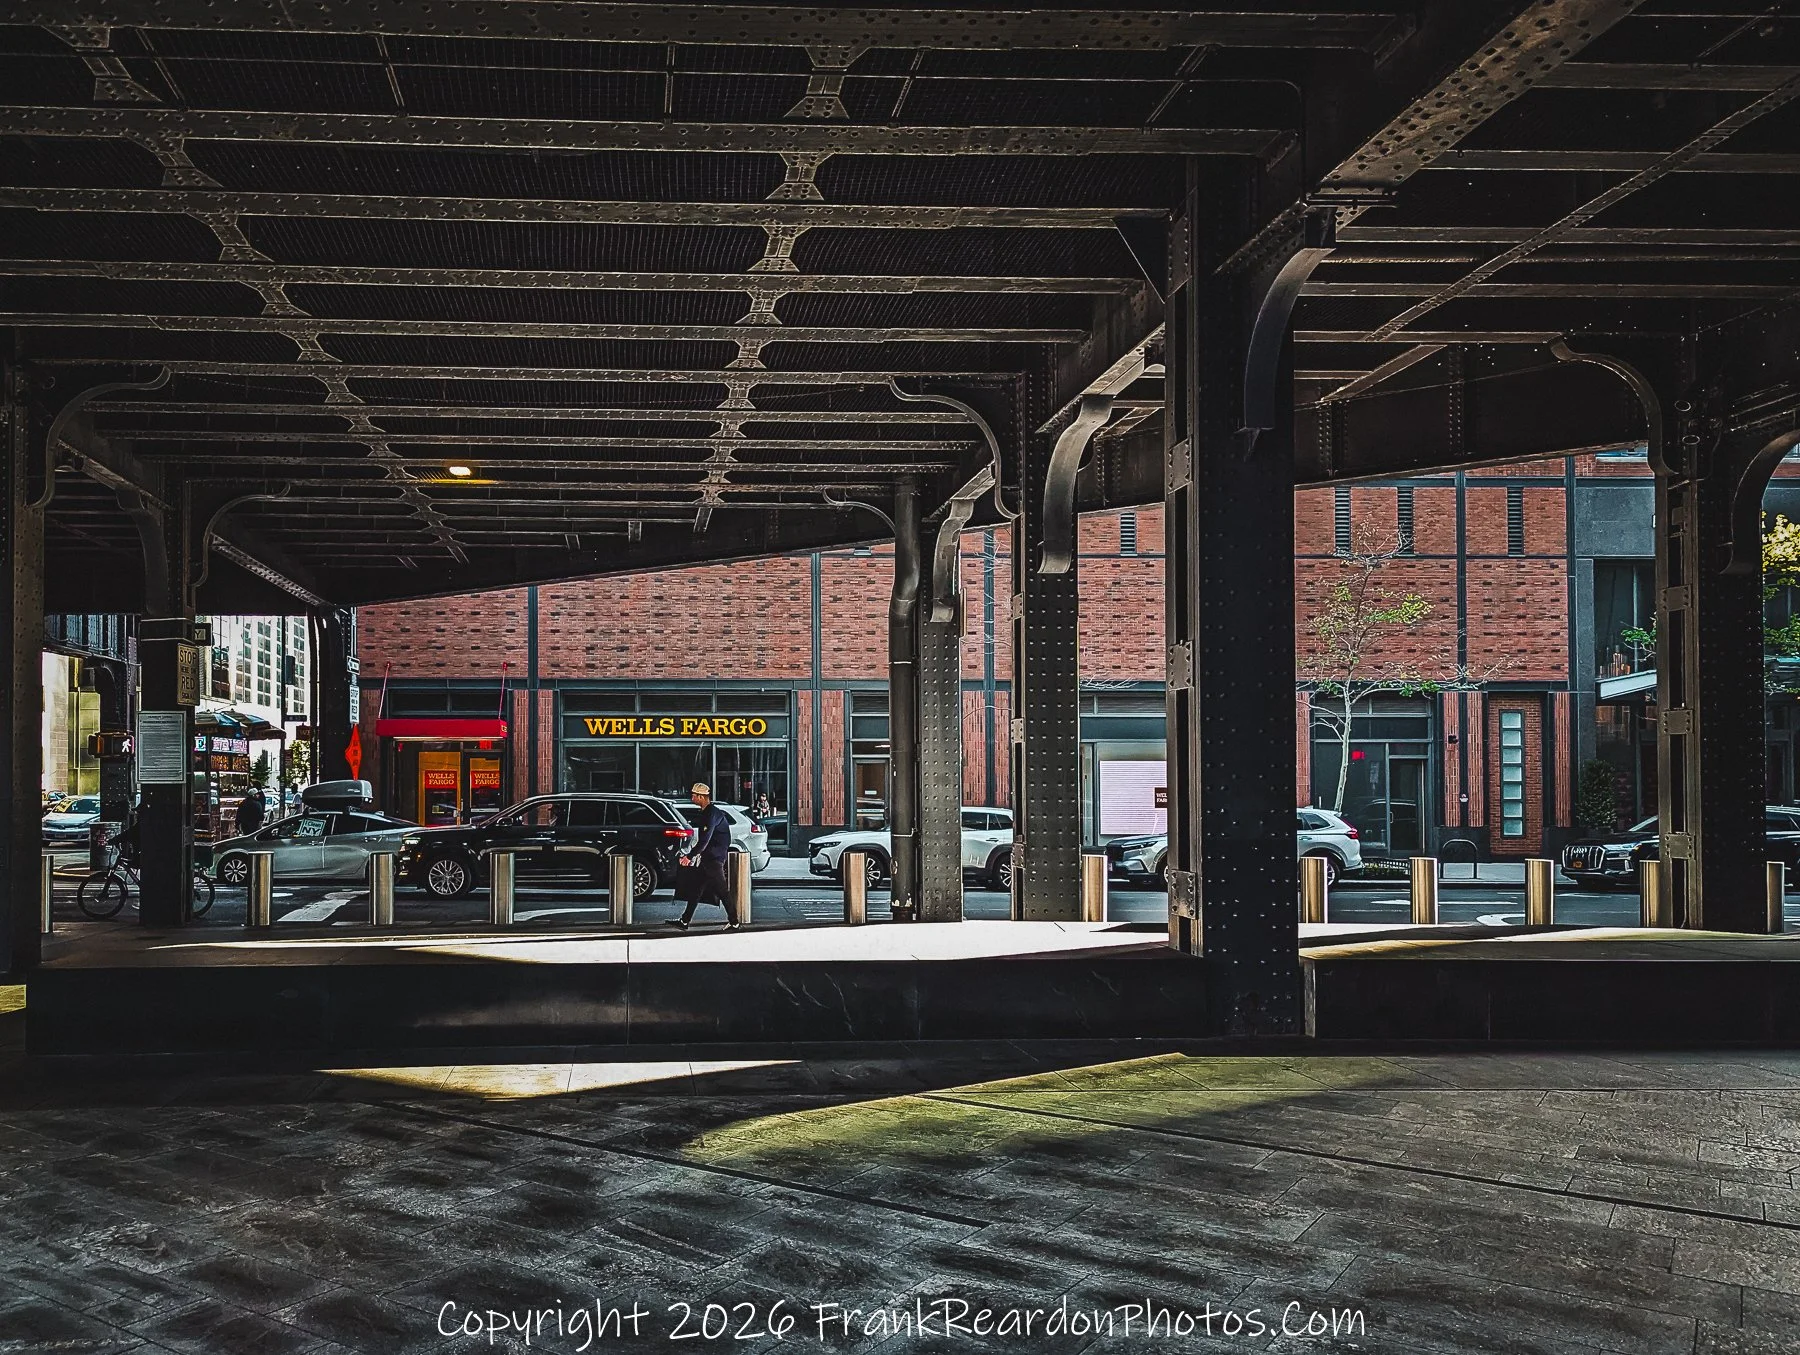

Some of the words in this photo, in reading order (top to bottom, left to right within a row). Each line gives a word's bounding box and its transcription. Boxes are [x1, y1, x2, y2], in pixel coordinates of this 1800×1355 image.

[179, 649, 198, 664] STOP
[181, 676, 195, 690] RED
[583, 718, 675, 736] WELLS
[680, 718, 767, 736] FARGO
[302, 827, 322, 835] NY
